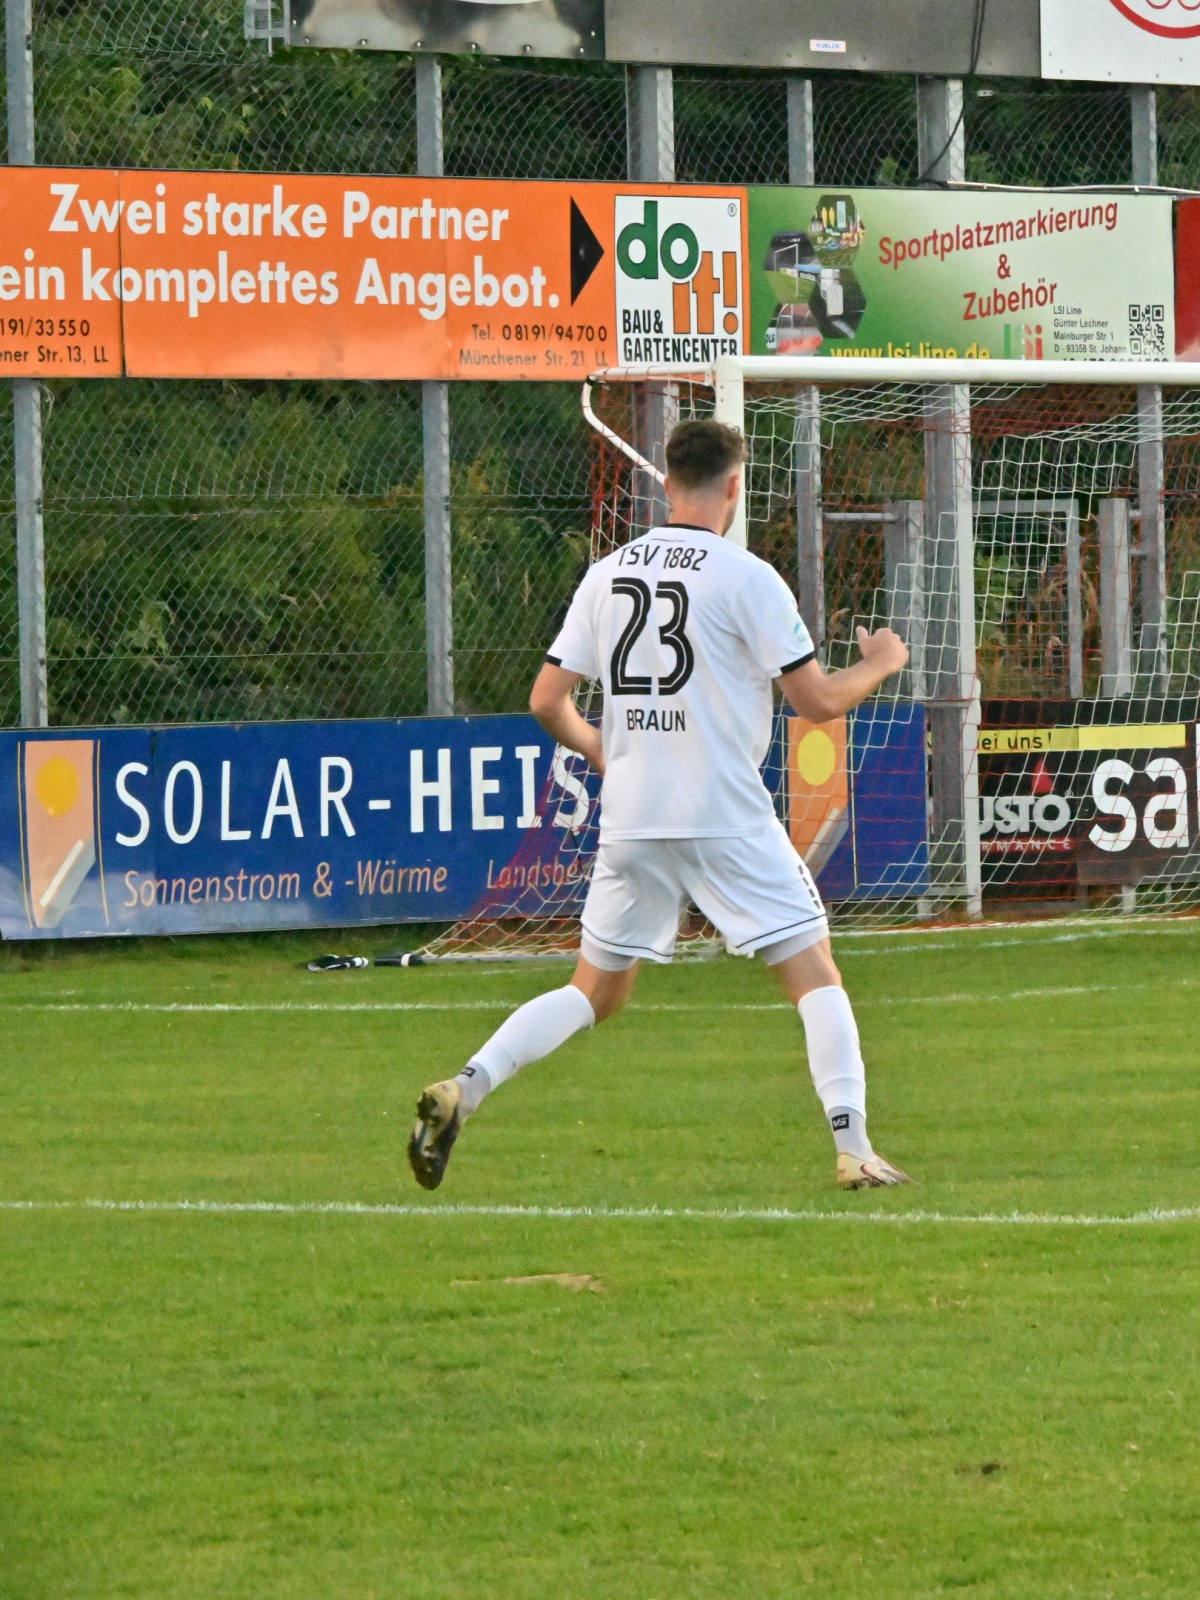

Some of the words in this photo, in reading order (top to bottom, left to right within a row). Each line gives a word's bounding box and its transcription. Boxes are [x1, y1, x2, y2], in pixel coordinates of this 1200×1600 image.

[49, 183, 167, 235] Zwei
[182, 184, 327, 239] starke
[343, 190, 509, 242] Partner
[616, 200, 699, 280] do
[878, 202, 1119, 270] Sportplatzmarkierung
[996, 254, 1012, 279] &
[0, 249, 66, 301] ein
[82, 248, 339, 318] komplettes
[355, 256, 560, 321] Angebot.
[672, 251, 739, 335] it!
[962, 279, 1056, 321] Zubehör
[1066, 306, 1082, 315] Line
[471, 323, 496, 341] Tel.
[1053, 318, 1077, 329] Günter
[1079, 318, 1108, 329] Lechner
[623, 337, 738, 363] GARTENCENTER
[1053, 331, 1094, 344] Mainburger
[1066, 344, 1088, 354] 93358
[459, 348, 538, 366] Münchener
[618, 544, 661, 567] TSV
[662, 546, 708, 572] 1882
[610, 577, 694, 696] 23
[626, 708, 686, 732] BRAUN
[124, 869, 301, 908] Sonnenstrom
[314, 862, 332, 897] &
[345, 858, 448, 897] -Wärme
